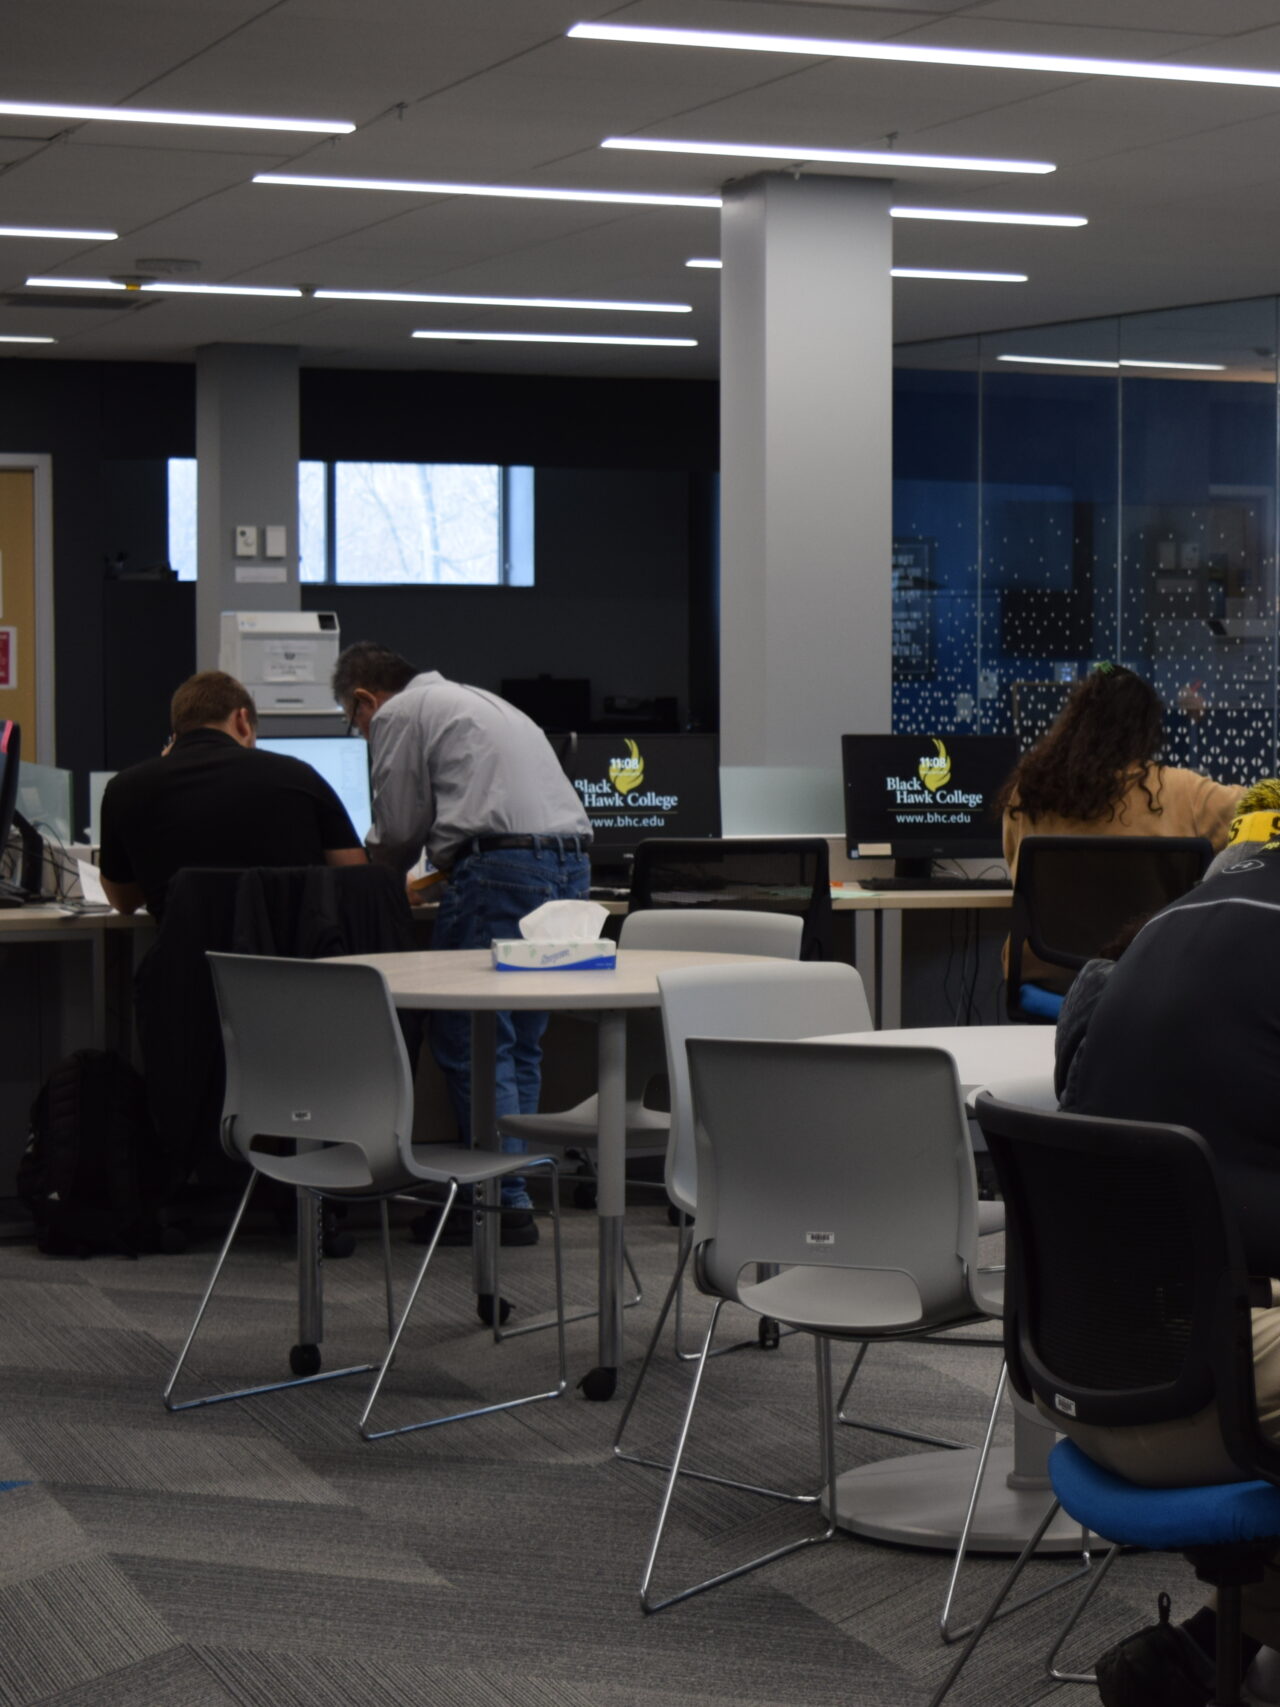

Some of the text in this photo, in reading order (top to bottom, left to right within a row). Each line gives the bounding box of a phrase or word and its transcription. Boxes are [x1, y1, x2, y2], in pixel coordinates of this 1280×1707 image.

[574, 778, 612, 794] Black
[886, 776, 922, 791] Black
[584, 791, 678, 811] Hawk College
[896, 789, 983, 808] Hawk College
[895, 812, 971, 823] www.bhc.edu
